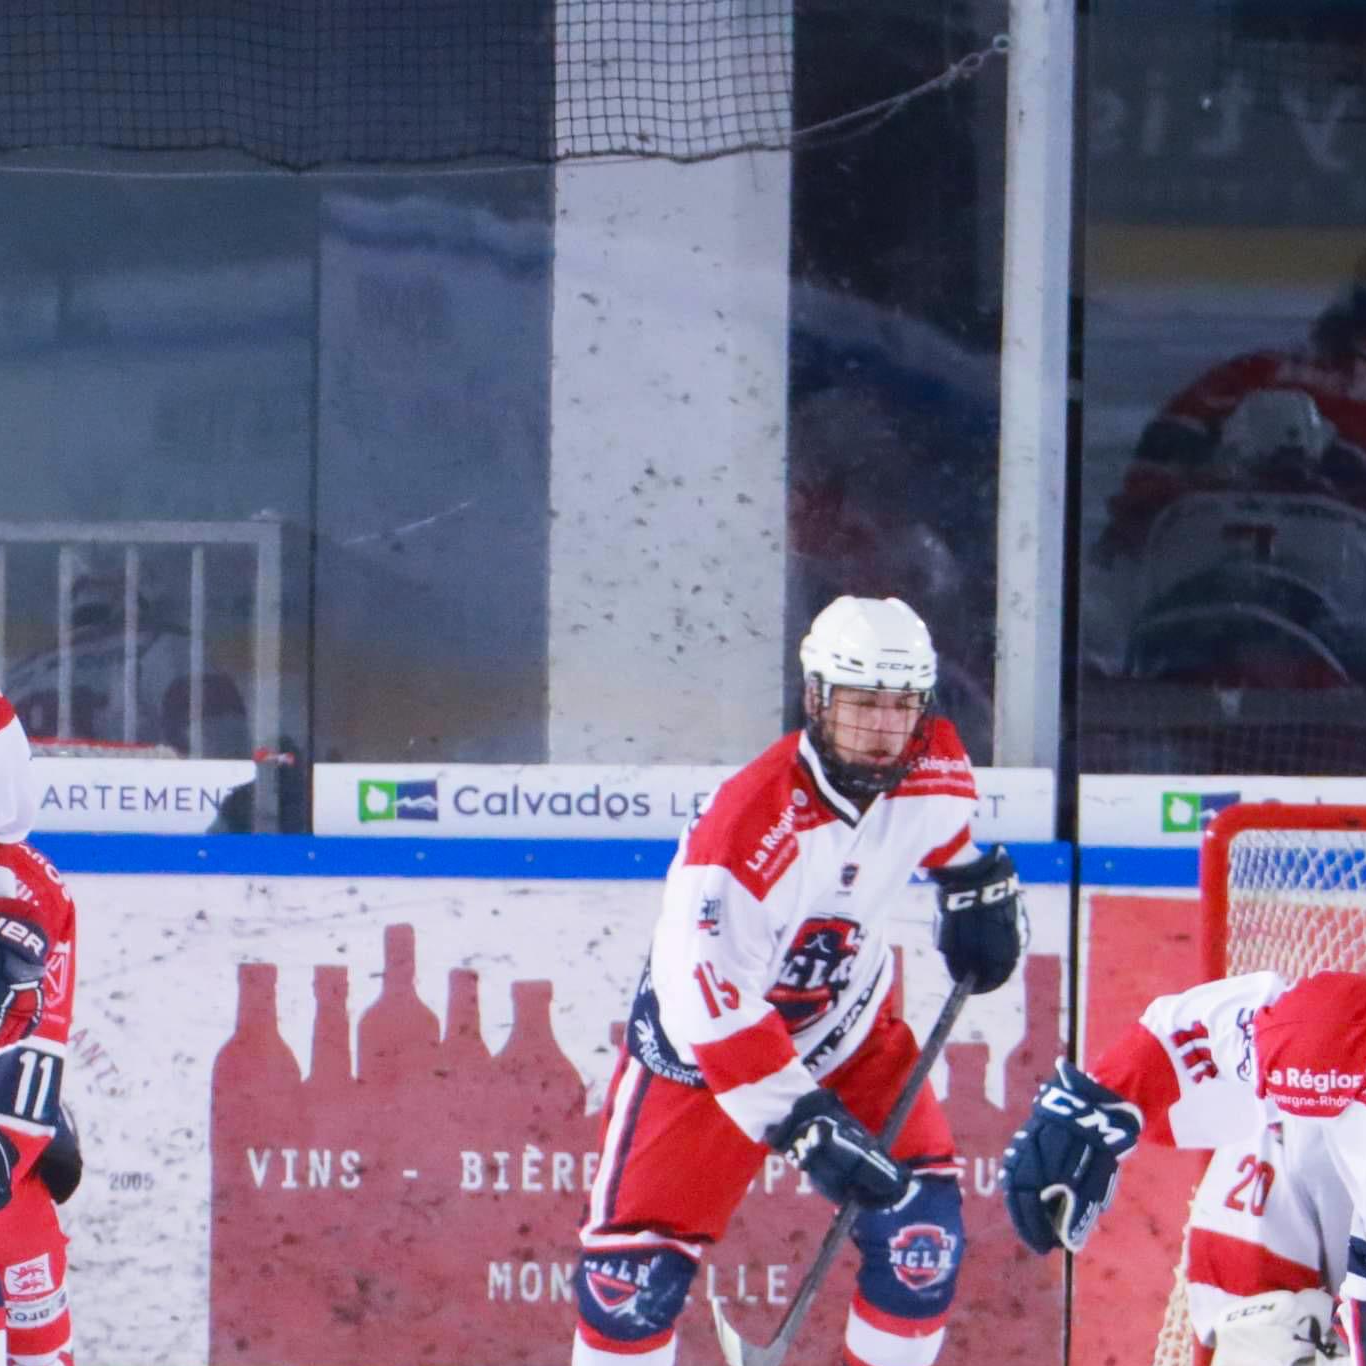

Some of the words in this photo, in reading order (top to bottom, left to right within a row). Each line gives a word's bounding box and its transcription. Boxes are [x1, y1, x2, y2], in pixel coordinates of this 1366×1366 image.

[453, 785, 651, 818] Calvados
[746, 850, 770, 872] La
[14, 1050, 55, 1121] 11
[247, 1148, 363, 1190] VINS
[1223, 1153, 1276, 1217] 20
[1226, 1302, 1276, 1323] CCM
